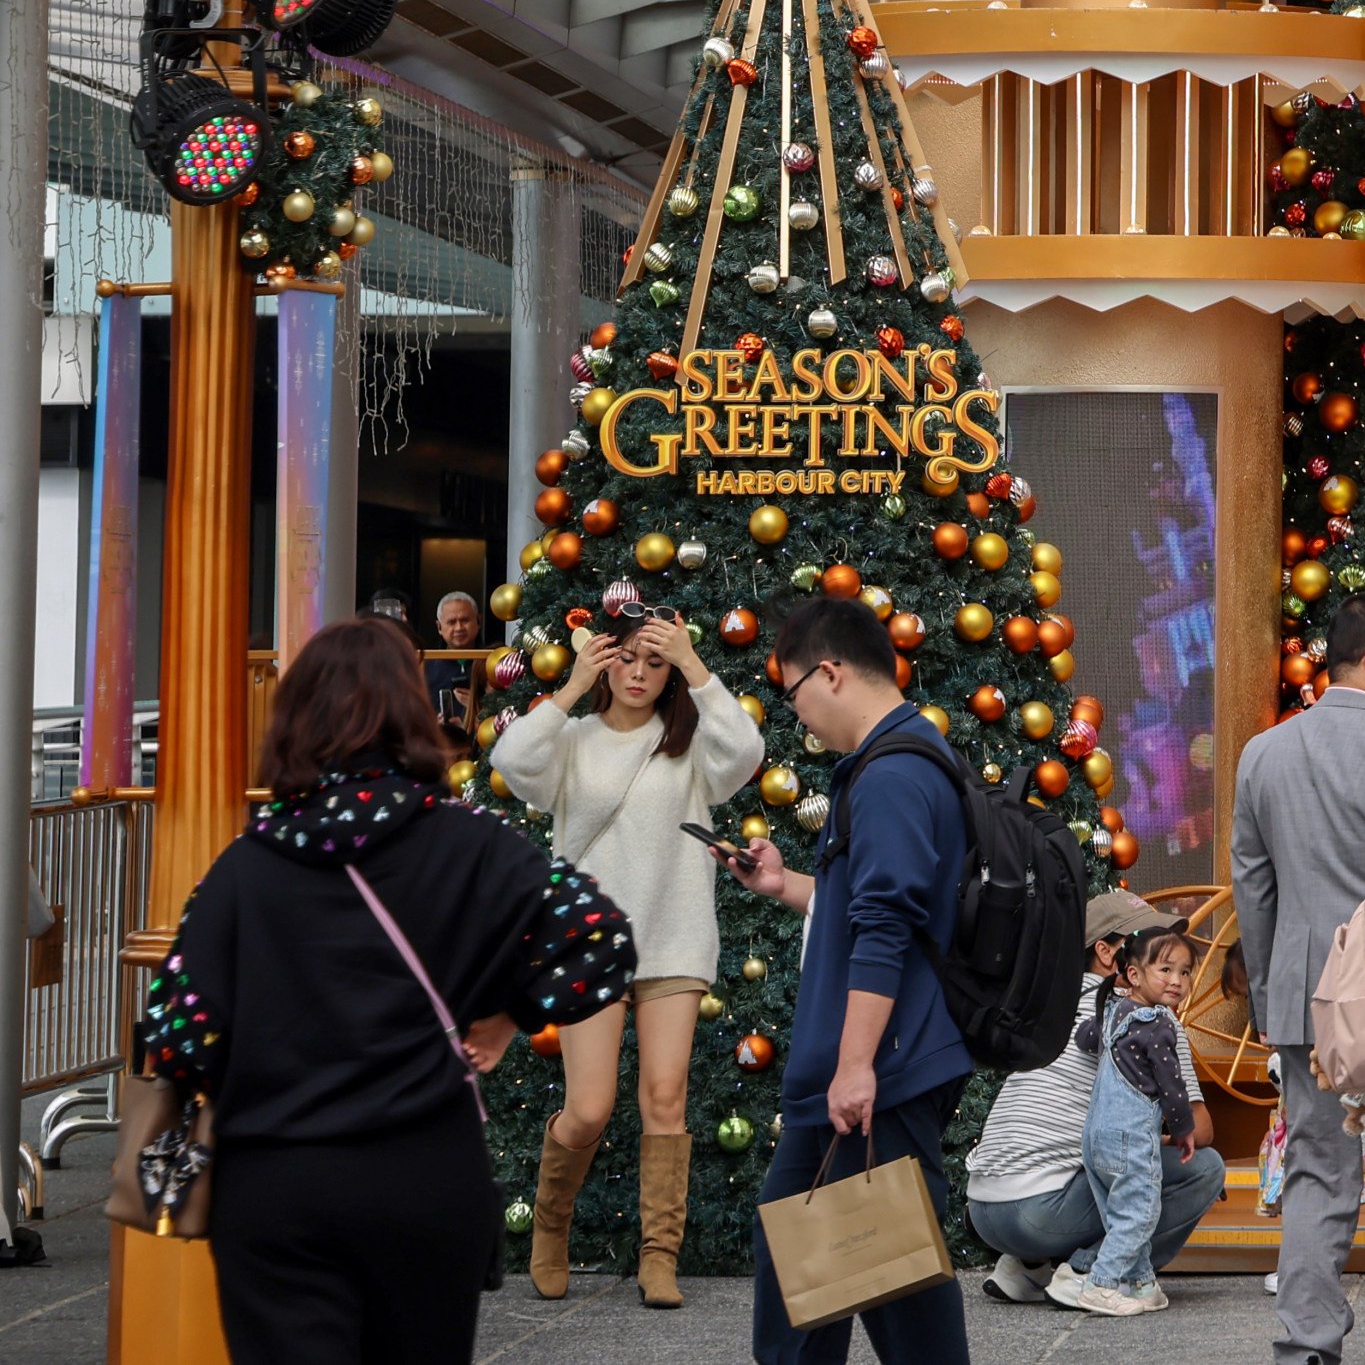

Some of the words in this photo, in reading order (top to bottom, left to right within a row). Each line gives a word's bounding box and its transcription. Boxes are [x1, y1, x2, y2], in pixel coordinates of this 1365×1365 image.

[681, 342, 957, 402] SEASON'S
[599, 387, 998, 484] GREETINGS
[696, 470, 837, 494] HARBOUR
[840, 469, 905, 494] CITY
